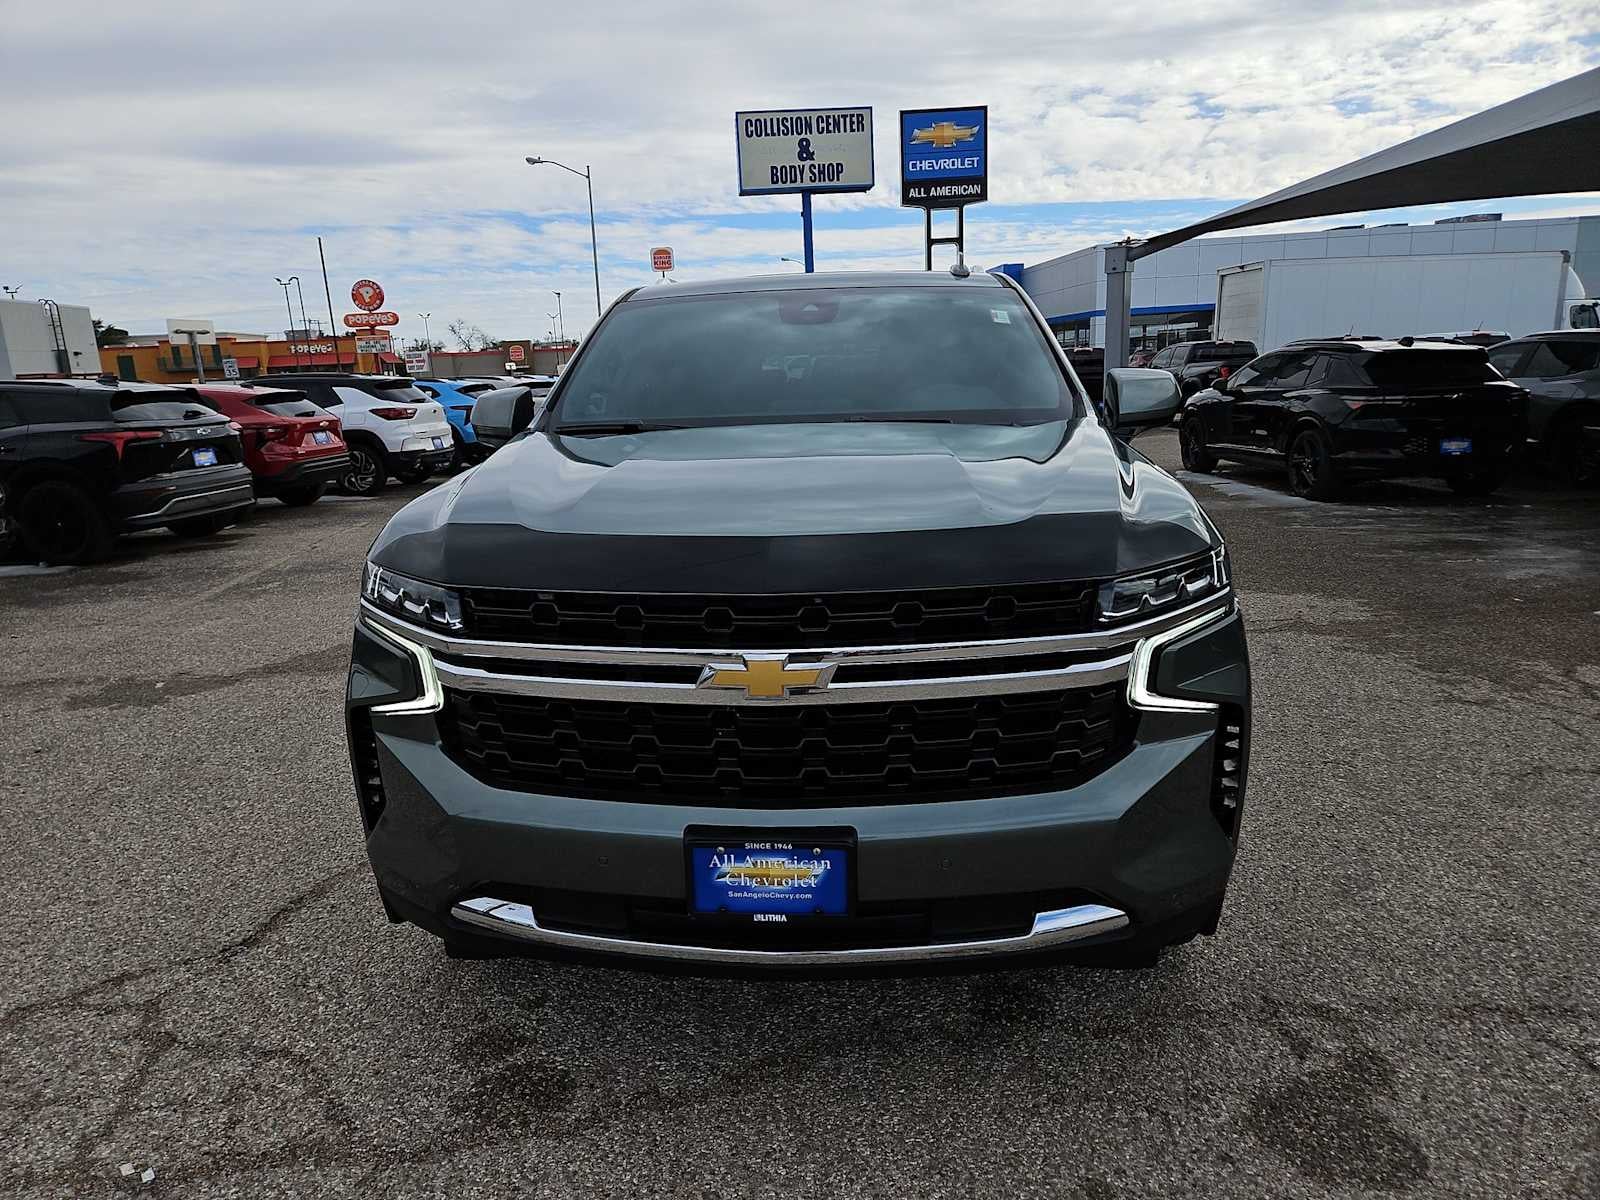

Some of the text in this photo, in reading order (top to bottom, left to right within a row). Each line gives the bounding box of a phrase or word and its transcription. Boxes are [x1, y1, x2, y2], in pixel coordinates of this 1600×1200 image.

[744, 113, 865, 138] COLLISION CENTER
[797, 137, 816, 162] &
[908, 157, 980, 171] CHEVROLET
[770, 162, 844, 184] BODY SHOP
[908, 184, 981, 198] ALL AMERICAN
[225, 368, 238, 377] 35
[744, 842, 793, 850] SINCE 1946
[709, 854, 832, 870] All American
[726, 872, 817, 888] Chevrolet
[727, 890, 813, 900] SanAngeloChevy.com
[761, 914, 788, 922] LITHIA
